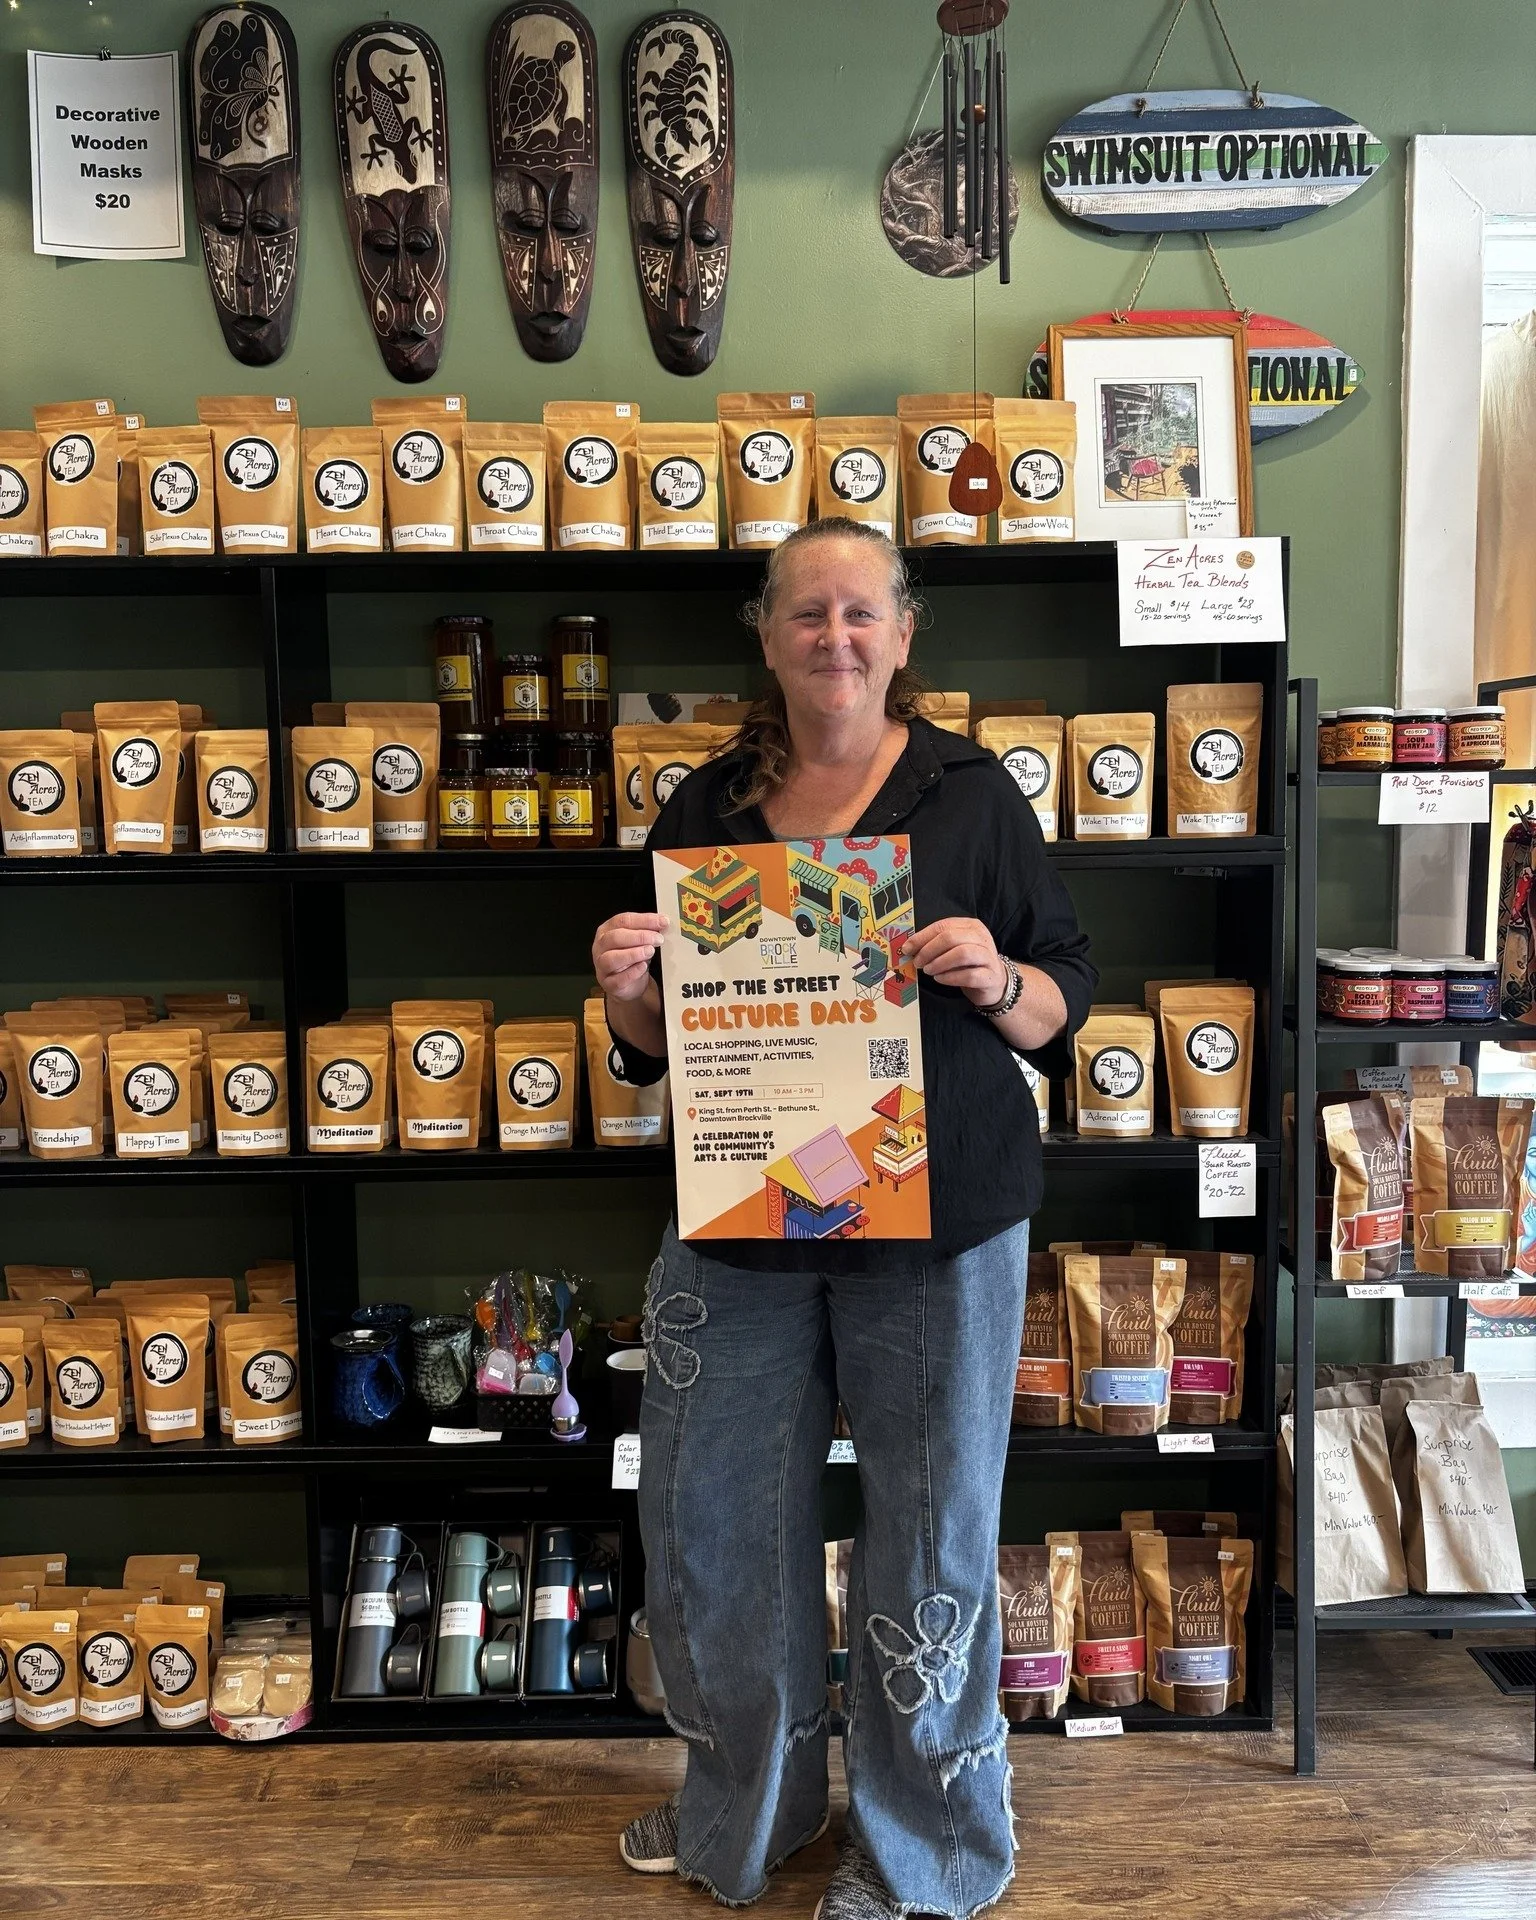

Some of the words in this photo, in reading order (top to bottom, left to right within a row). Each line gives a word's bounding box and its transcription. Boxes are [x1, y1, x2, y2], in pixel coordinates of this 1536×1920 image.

[56, 106, 160, 121] Decorative
[71, 135, 148, 150] Wooden
[1046, 135, 1210, 187] SWIMSUIT
[1217, 132, 1373, 182] OPTIONAL
[81, 163, 142, 178] Masks
[95, 193, 130, 209] $20
[1248, 357, 1350, 401] TIONAL
[852, 471, 877, 481] Acres
[500, 480, 526, 491] Acres
[850, 485, 864, 494] TEA
[498, 494, 513, 503] TEA
[918, 517, 943, 530] Crown
[945, 516, 972, 529] Chakra
[316, 530, 337, 538] Heart
[339, 528, 372, 538] Chakra
[477, 526, 506, 536] Throat
[508, 526, 537, 537] Chakra
[646, 528, 666, 536] Third
[667, 524, 683, 536] Eye
[685, 526, 713, 534] Chakra
[1143, 548, 1182, 570] ZEN
[1185, 544, 1223, 569] ACRES
[1135, 575, 1175, 589] HERBAL
[1178, 572, 1204, 587] Tea
[1208, 573, 1249, 589] Blends
[1135, 600, 1161, 613] Small
[1170, 601, 1190, 611] $14
[1201, 600, 1233, 614] Large
[1238, 596, 1254, 609] $28
[1164, 614, 1190, 623] servings
[1237, 614, 1262, 623] servings
[1212, 752, 1236, 762] Acres
[1210, 764, 1224, 772] TEA
[1392, 776, 1407, 787] Red
[1412, 776, 1434, 786] Door
[1440, 774, 1484, 787] Provisions
[326, 781, 352, 792] Acres
[324, 795, 338, 803] TEA
[1419, 802, 1437, 812] $12
[1104, 817, 1119, 825] The
[219, 829, 239, 837] Apple
[241, 830, 263, 840] Spice
[309, 831, 360, 842] ClearHead
[760, 943, 796, 956] BROCK
[762, 955, 798, 964] VILLE
[682, 981, 726, 998] SHOP
[733, 980, 766, 995] THE
[773, 975, 840, 994] STREET
[682, 1003, 800, 1031] CULTURE
[811, 1000, 877, 1025] DAYS
[684, 1042, 713, 1050] LOCAL
[715, 1040, 764, 1049] SHOPPING,
[765, 1039, 783, 1047] LIVE
[785, 1037, 817, 1047] MUSIC,
[685, 1053, 762, 1064] ENTERTAINMENT,
[763, 1051, 814, 1061] ACTIVITIES,
[686, 1069, 714, 1078] FOOD,
[725, 1068, 751, 1076] MORE
[1112, 1068, 1137, 1079] Acres
[1362, 1069, 1386, 1078] Coffee
[338, 1081, 364, 1091] Acres
[1110, 1082, 1124, 1090] TEA
[695, 1091, 711, 1099] SAT,
[735, 1089, 753, 1097] 19TH
[699, 1107, 715, 1115] King
[1086, 1112, 1119, 1121] Adrenal
[1120, 1113, 1144, 1122] Crone
[317, 1128, 373, 1139] Meditation
[504, 1126, 529, 1135] Orange
[531, 1126, 548, 1134] Mint
[549, 1124, 566, 1133] Bliss
[253, 1131, 283, 1142] Boost
[702, 1131, 760, 1140] CELEBRATION
[763, 1131, 774, 1139] OF
[126, 1136, 154, 1148] Happy
[155, 1135, 179, 1145] Time
[694, 1143, 711, 1151] OUR
[714, 1140, 774, 1150] COMMUNITY'S
[694, 1154, 717, 1162] ARTS
[720, 1153, 727, 1161] &
[731, 1152, 768, 1161] CULTURE
[1202, 1146, 1245, 1163] Fluid
[1206, 1170, 1238, 1180] COFFEE
[1455, 1181, 1497, 1194] COFFEE
[1354, 1287, 1387, 1295] Decaf
[1464, 1285, 1486, 1294] Half
[1109, 1341, 1150, 1354] COFFEE
[158, 1355, 180, 1365] Acres
[239, 1422, 268, 1431] Sweet
[618, 1444, 637, 1452] Color
[1164, 1437, 1188, 1449] Light
[1424, 1436, 1473, 1453] Surprise
[619, 1455, 634, 1465] Mug
[1441, 1456, 1467, 1473] Bag
[1324, 1469, 1346, 1484] Bag
[1439, 1505, 1453, 1515] Min
[1325, 1520, 1341, 1531] Min
[1343, 1518, 1363, 1529] Value
[102, 1704, 116, 1713] Earl
[118, 1700, 135, 1711] Grey
[1070, 1723, 1096, 1732] Medium
[1100, 1721, 1119, 1731] Roast
